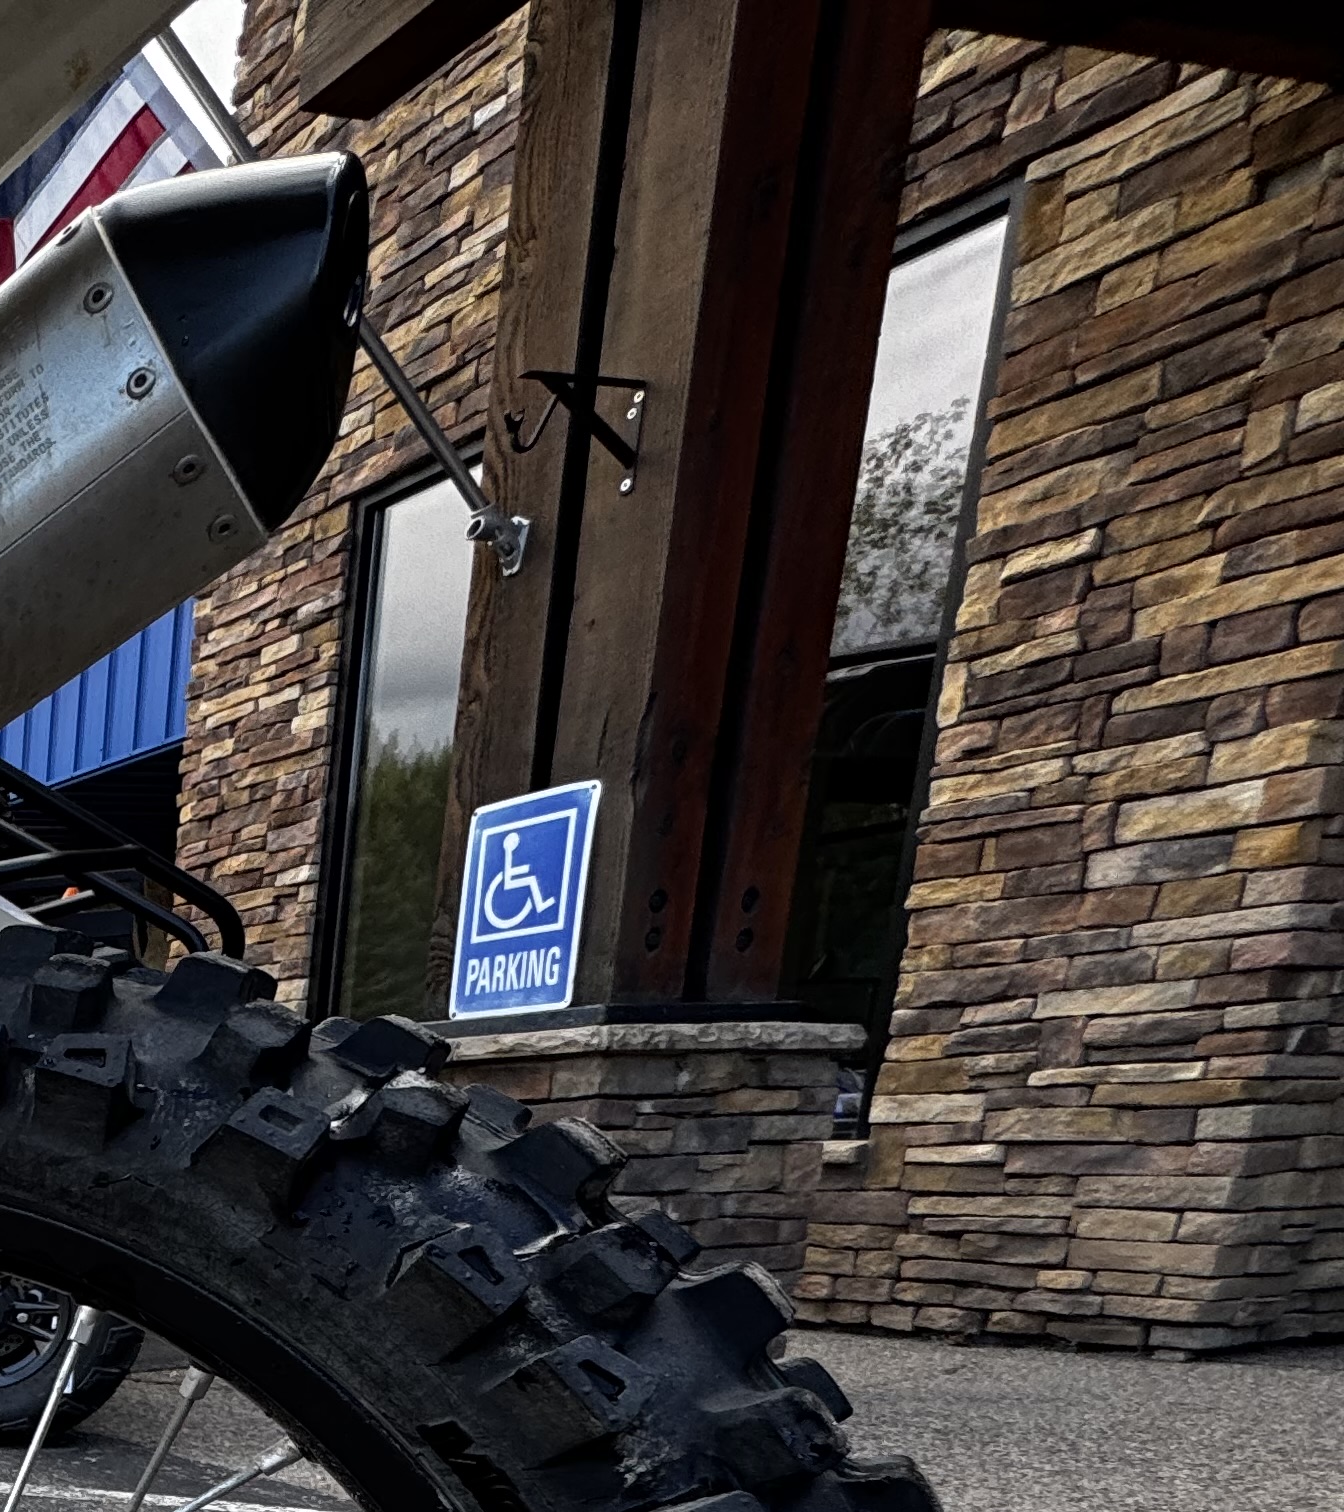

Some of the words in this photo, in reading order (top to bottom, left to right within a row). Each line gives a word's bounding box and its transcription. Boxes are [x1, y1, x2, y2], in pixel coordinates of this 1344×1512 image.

[30, 364, 44, 377] TO
[6, 408, 50, 445] UNLESS
[19, 431, 41, 451] THE
[465, 946, 561, 996] PARKING
